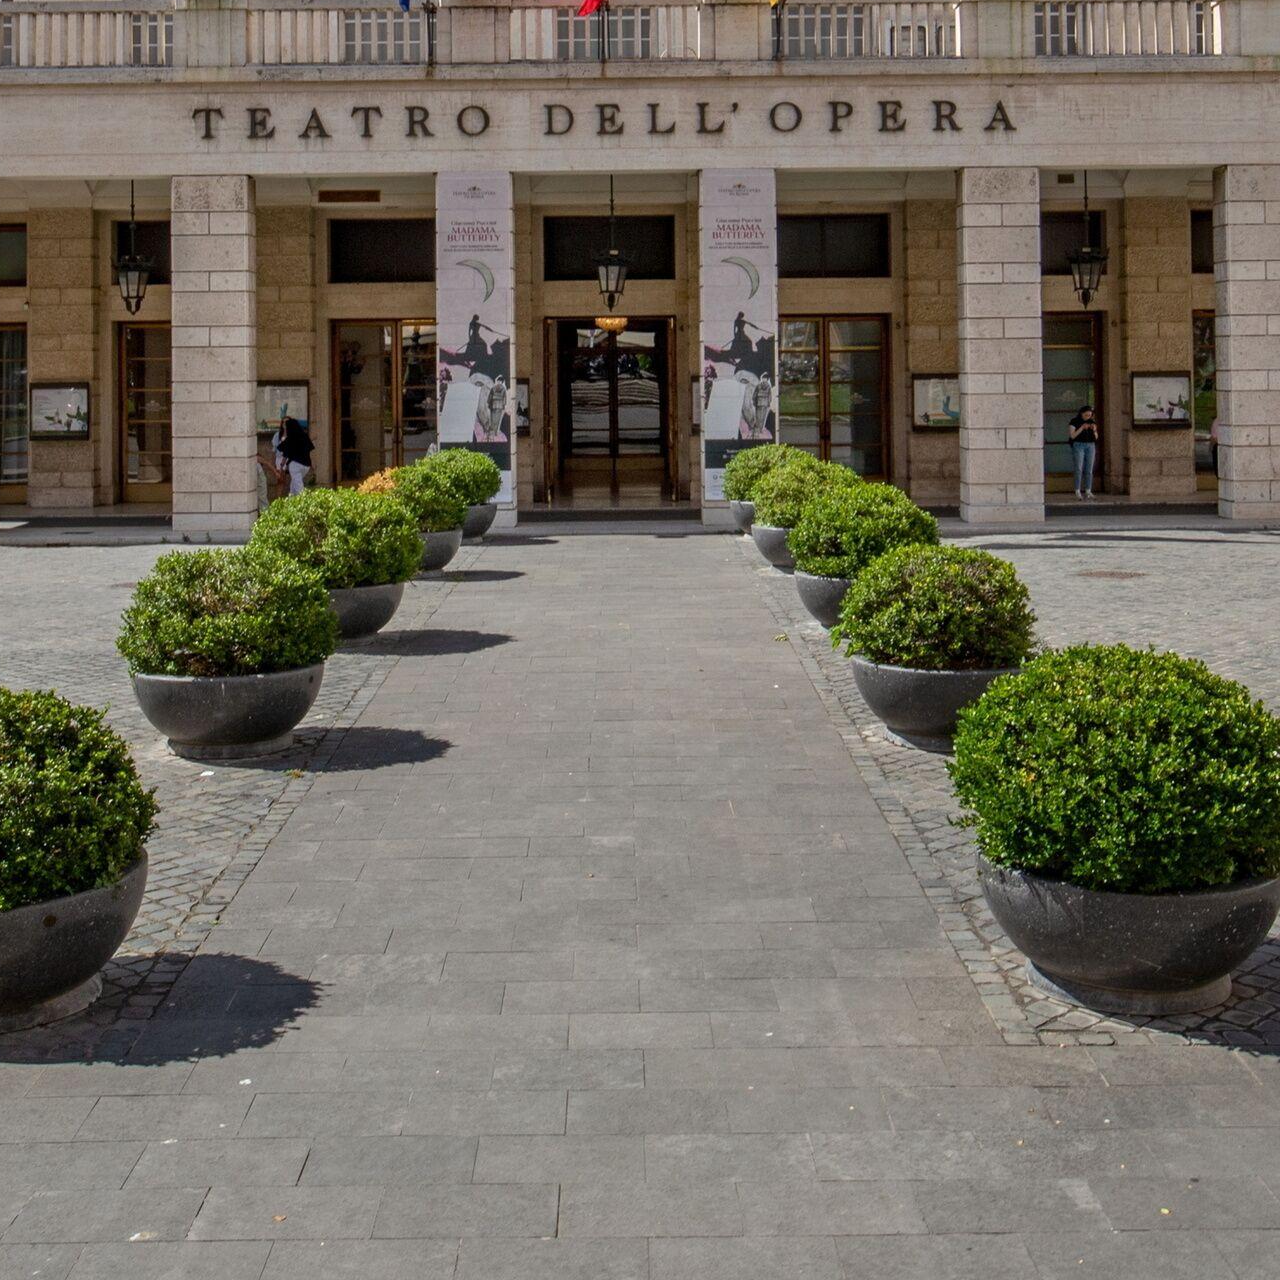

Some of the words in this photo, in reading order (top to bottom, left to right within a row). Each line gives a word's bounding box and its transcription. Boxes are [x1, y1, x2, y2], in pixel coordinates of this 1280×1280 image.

[192, 104, 491, 140] TEATRO
[543, 100, 1017, 136] DELL'OPERA
[712, 231, 765, 239] BUTTERFLY
